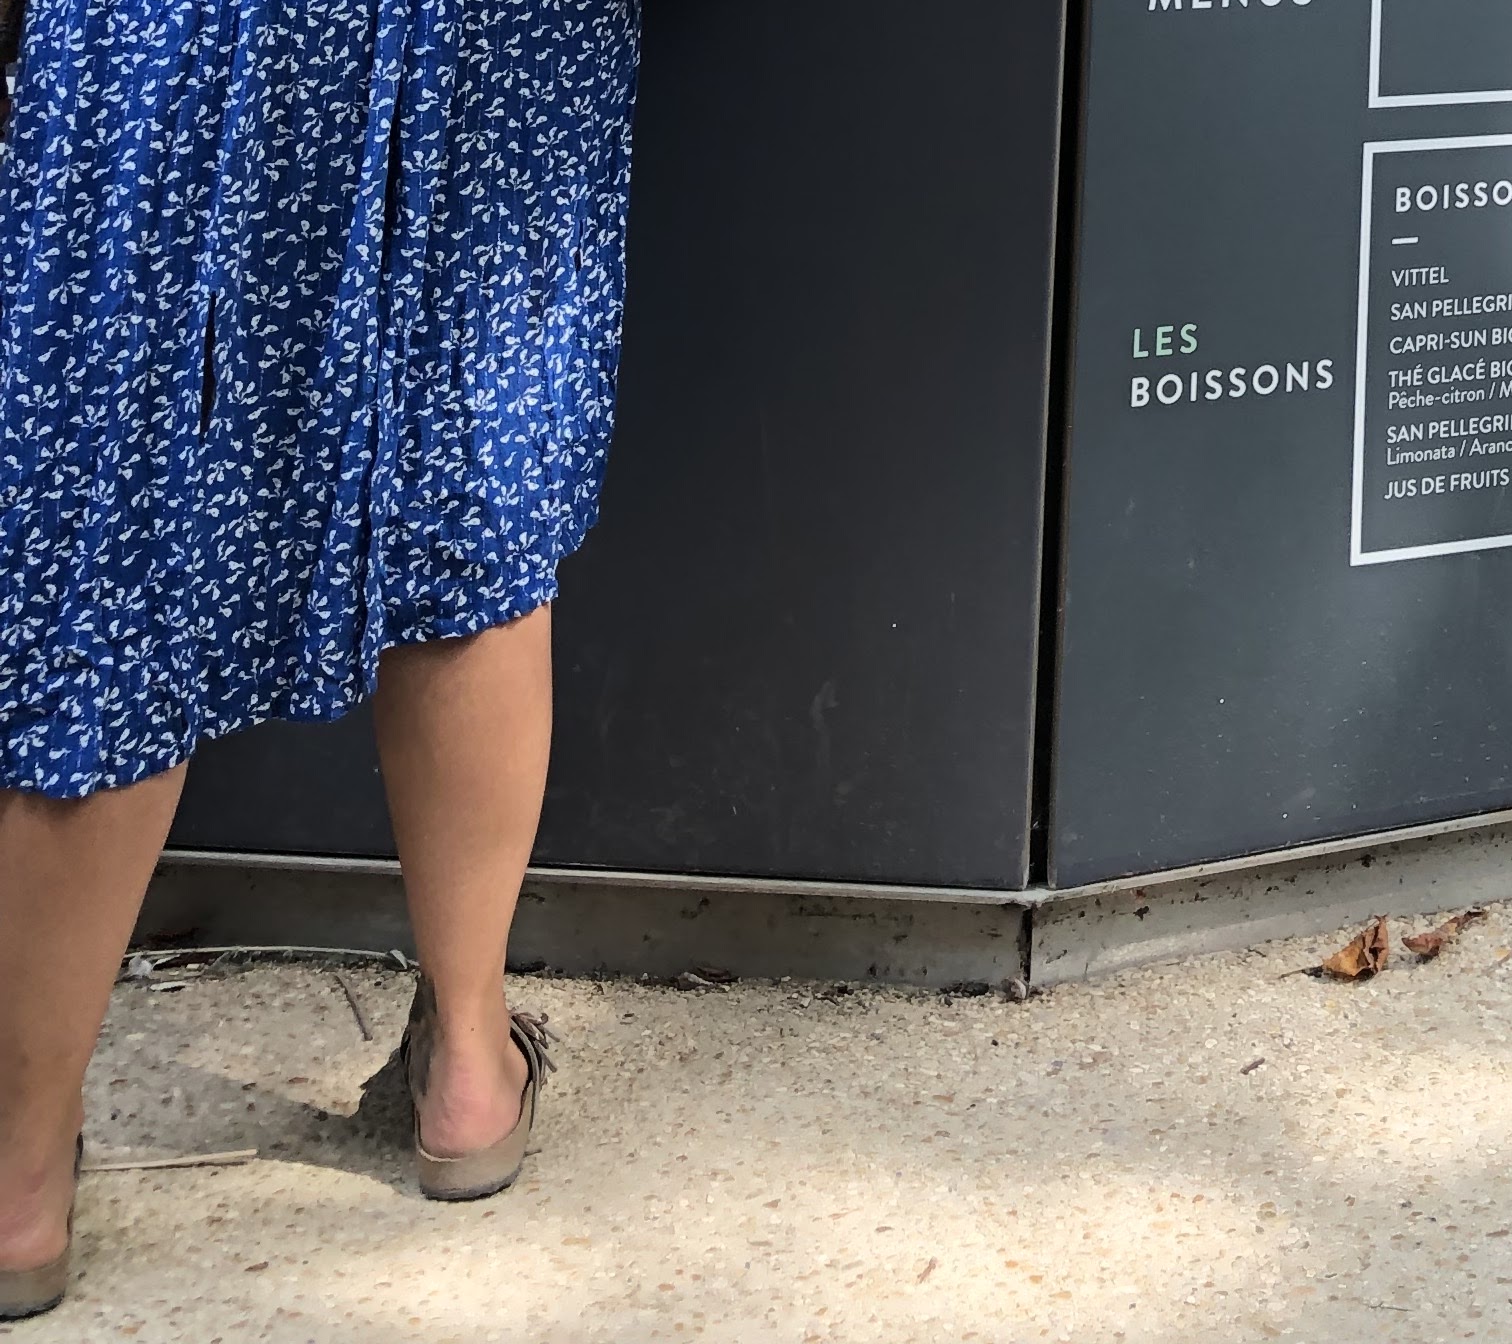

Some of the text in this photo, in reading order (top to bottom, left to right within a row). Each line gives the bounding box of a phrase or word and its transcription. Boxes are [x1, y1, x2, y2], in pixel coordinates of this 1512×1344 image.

[1391, 266, 1450, 287] VITTEL
[1390, 300, 1428, 321] SAN
[1132, 323, 1198, 359] LES
[1389, 328, 1487, 355] CAPRI-SUN
[1130, 358, 1334, 408] BOISSONS
[1387, 363, 1424, 388] THÉ
[1426, 357, 1486, 385] GLACÉ
[1388, 385, 1485, 410] Pêche-citron
[1386, 422, 1424, 444] SAN
[1386, 445, 1456, 466] Limonata
[1383, 478, 1418, 500] JUS
[1421, 475, 1446, 495] DE
[1449, 468, 1510, 492] FRUITS
